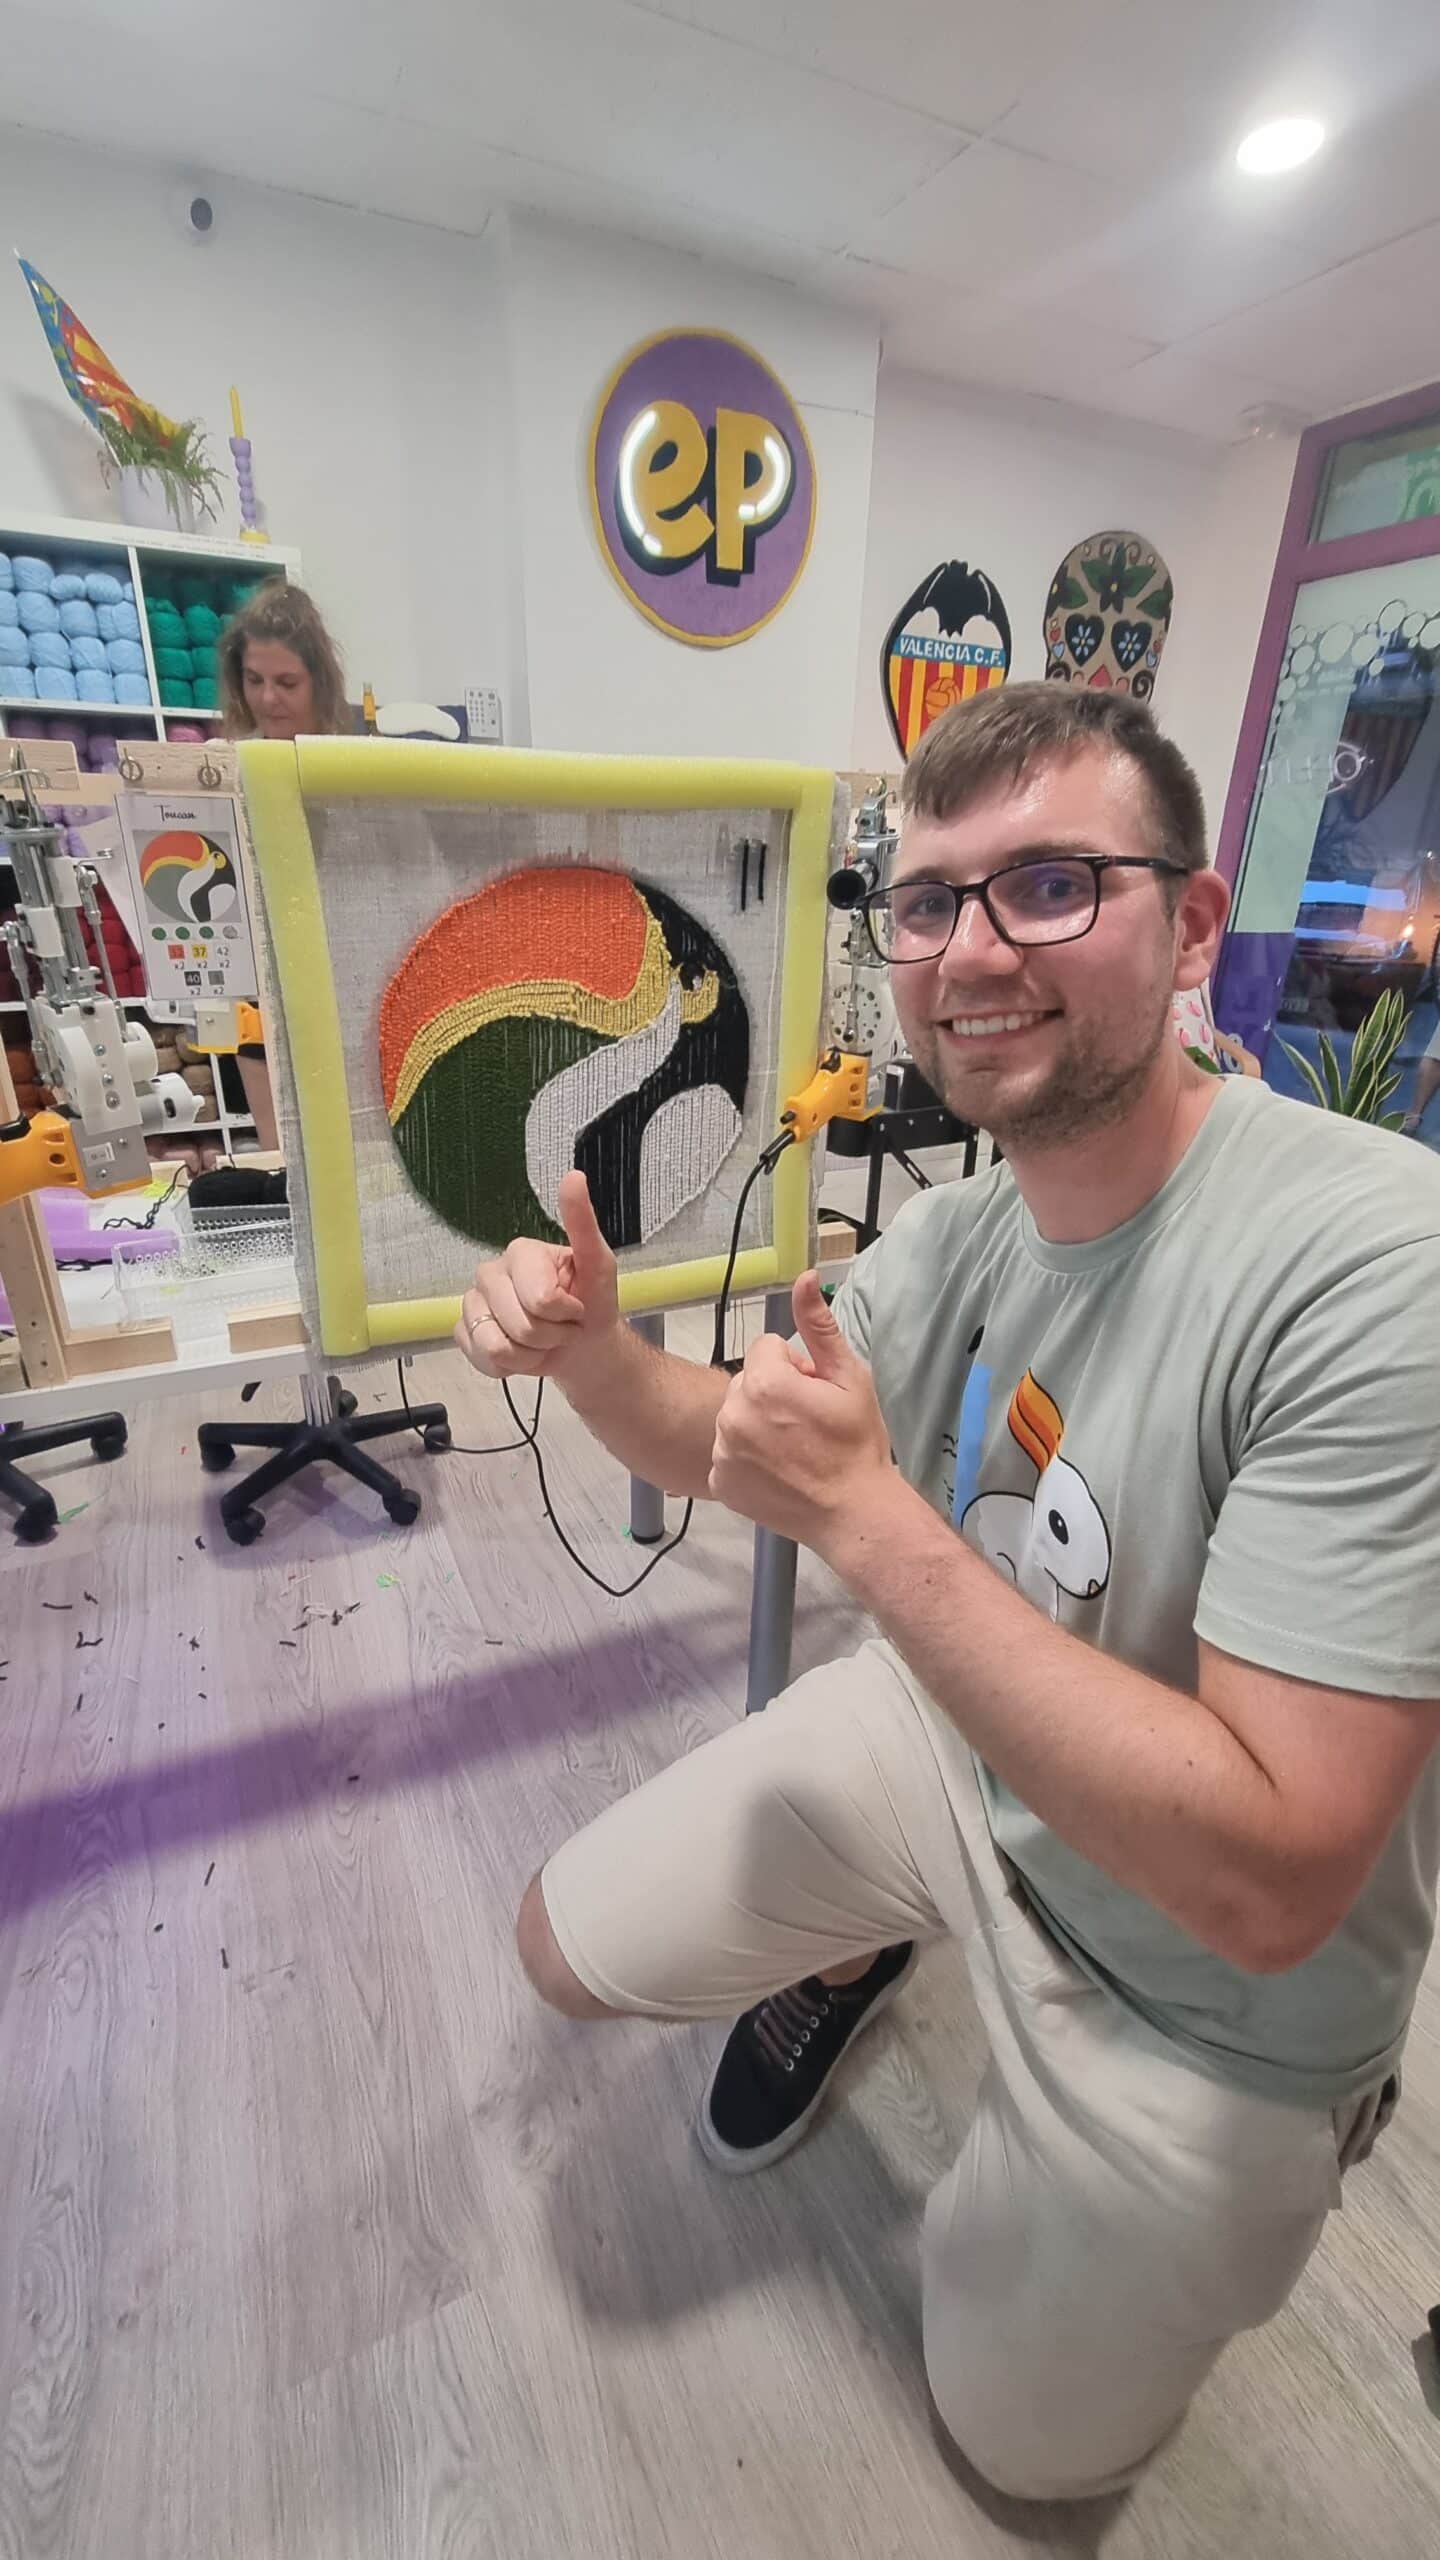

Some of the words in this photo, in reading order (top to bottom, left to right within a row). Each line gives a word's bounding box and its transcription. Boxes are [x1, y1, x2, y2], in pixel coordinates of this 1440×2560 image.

[616, 399, 795, 580] ep
[899, 636, 971, 662] VALENCIA
[153, 804, 196, 821] Toucan
[193, 945, 207, 957] 37
[216, 946, 229, 957] 42
[186, 974, 200, 984] 40
